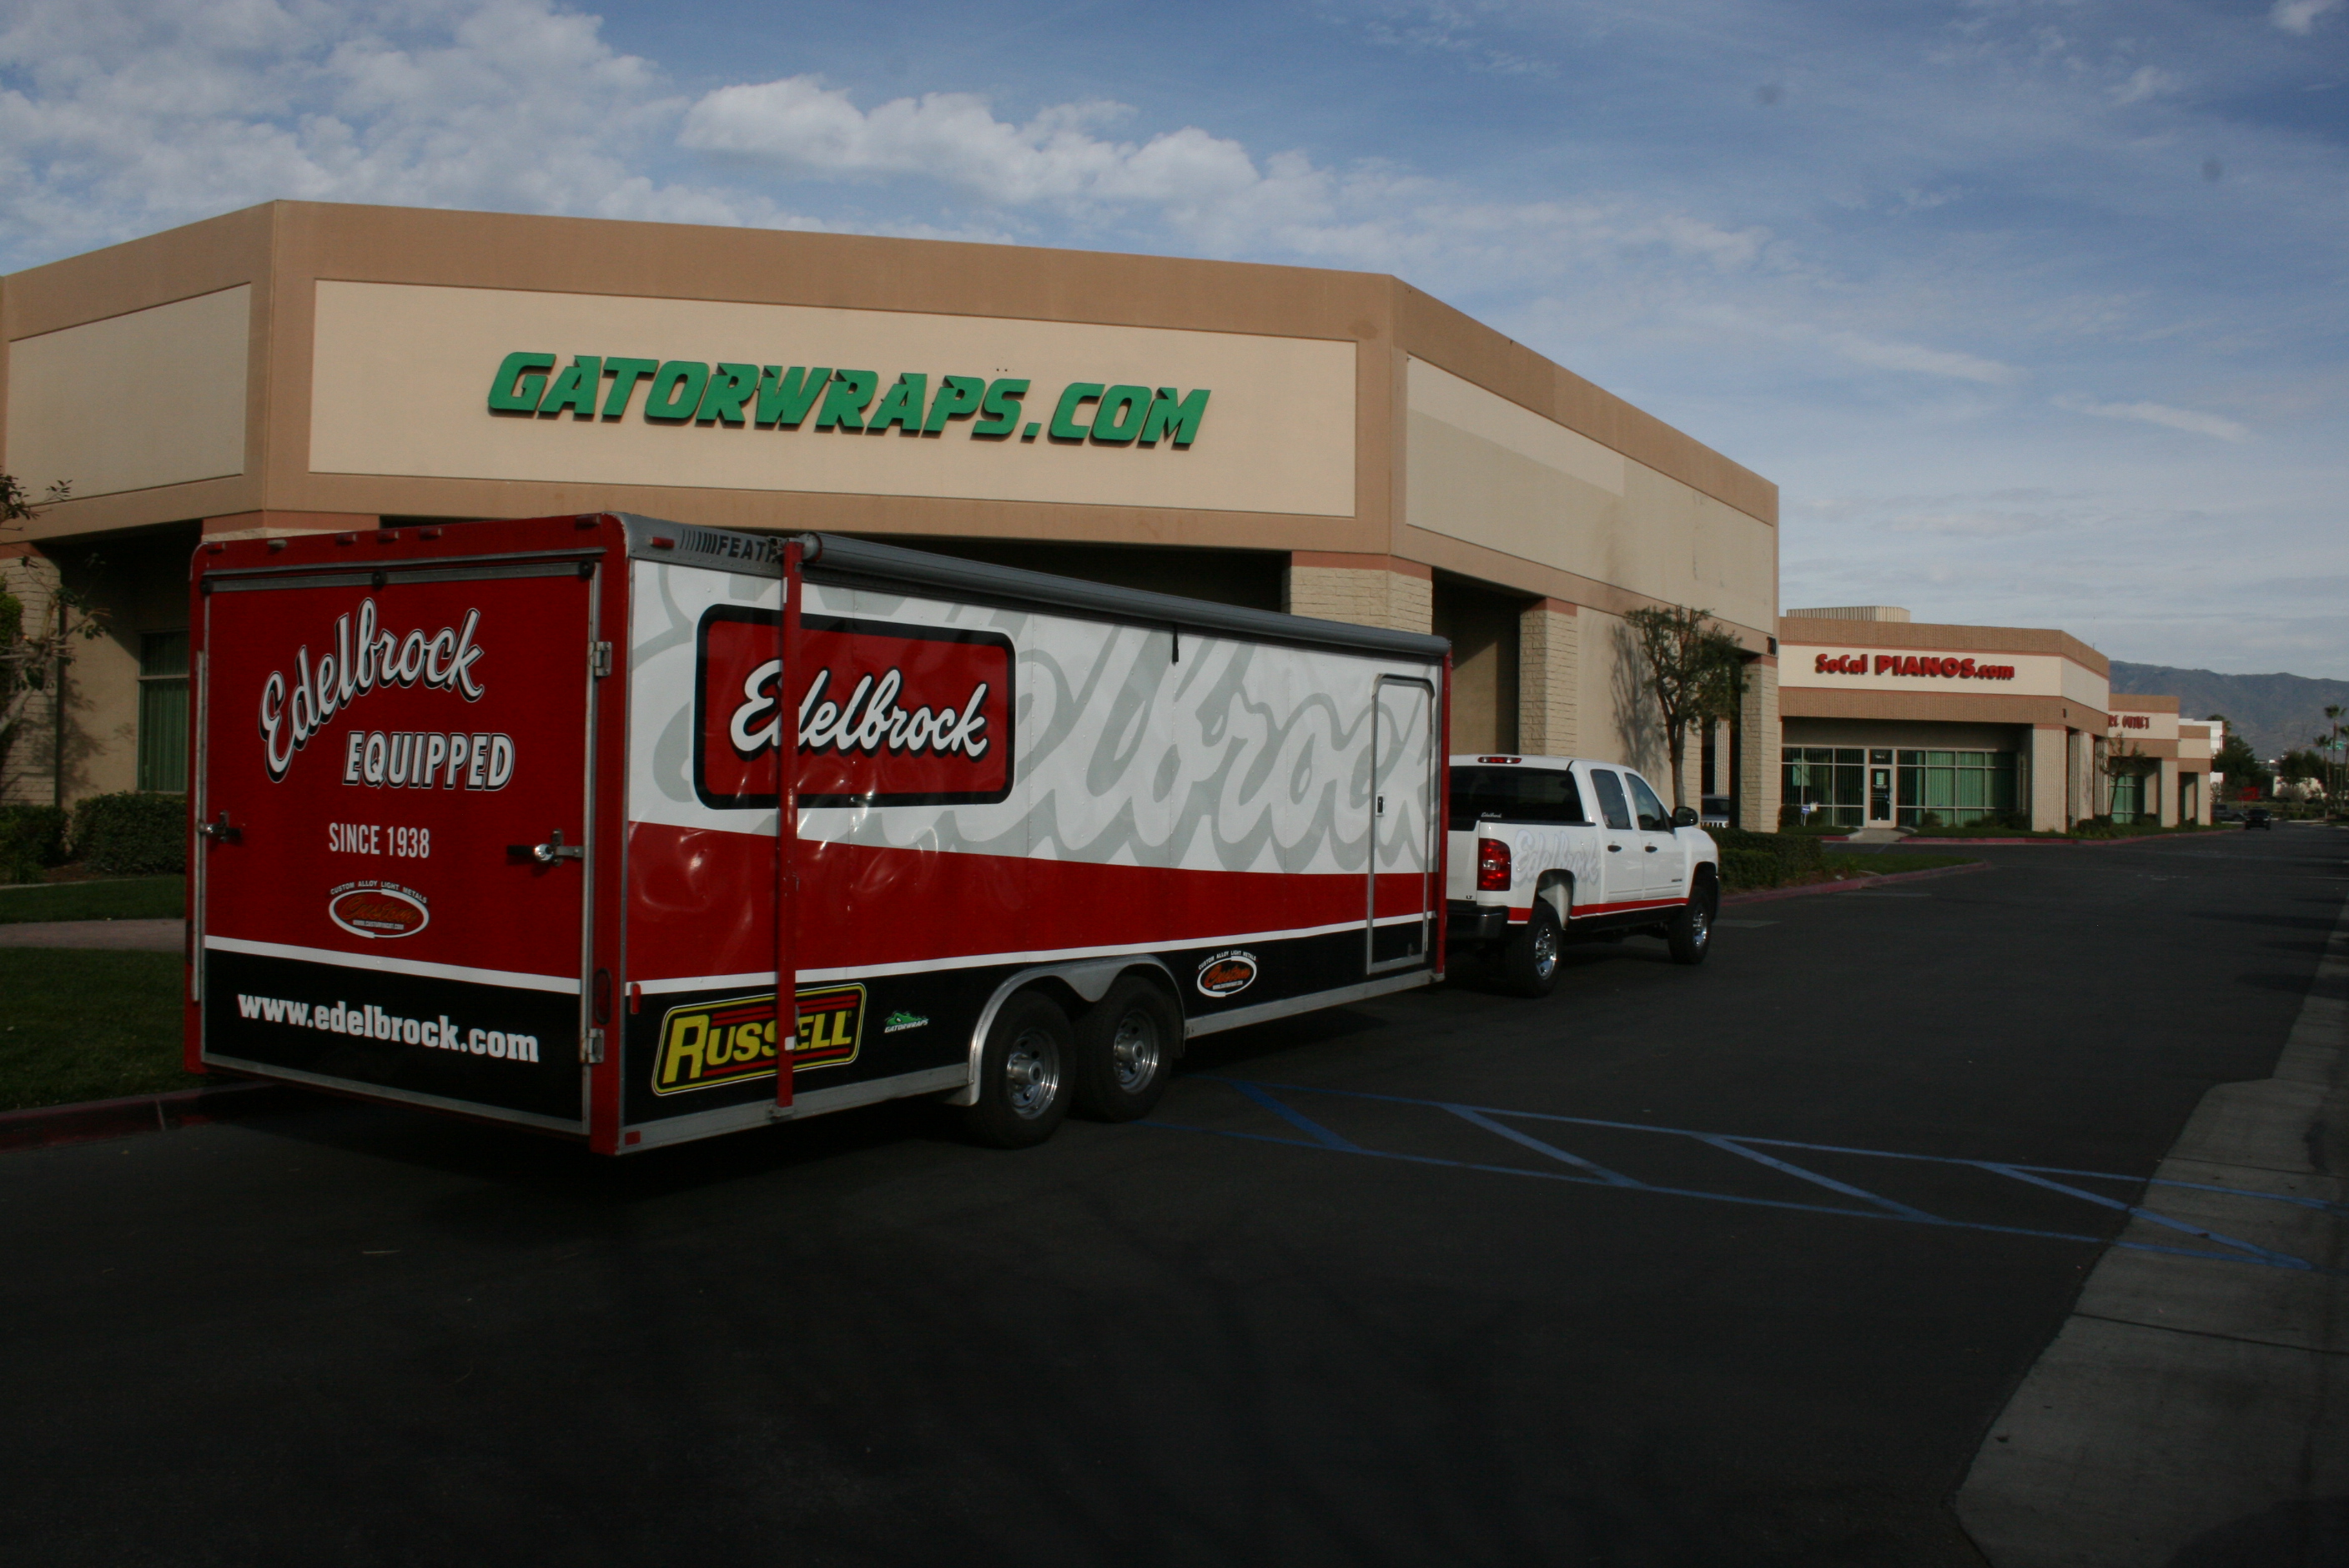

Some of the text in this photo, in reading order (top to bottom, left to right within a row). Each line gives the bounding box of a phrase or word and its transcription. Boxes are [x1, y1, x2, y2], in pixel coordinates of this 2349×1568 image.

[487, 351, 1211, 448] GATORWRAPS.COM
[259, 596, 485, 782] Edelbrock
[1815, 653, 1869, 674] SoCal
[729, 658, 988, 758] Edelbrock
[343, 730, 516, 792] EQUIPPED
[328, 822, 430, 859] SINCE 1938
[380, 881, 400, 891] LIGHT
[238, 993, 541, 1064] www.edelbrock.com
[662, 1013, 853, 1085] RUSSELL
